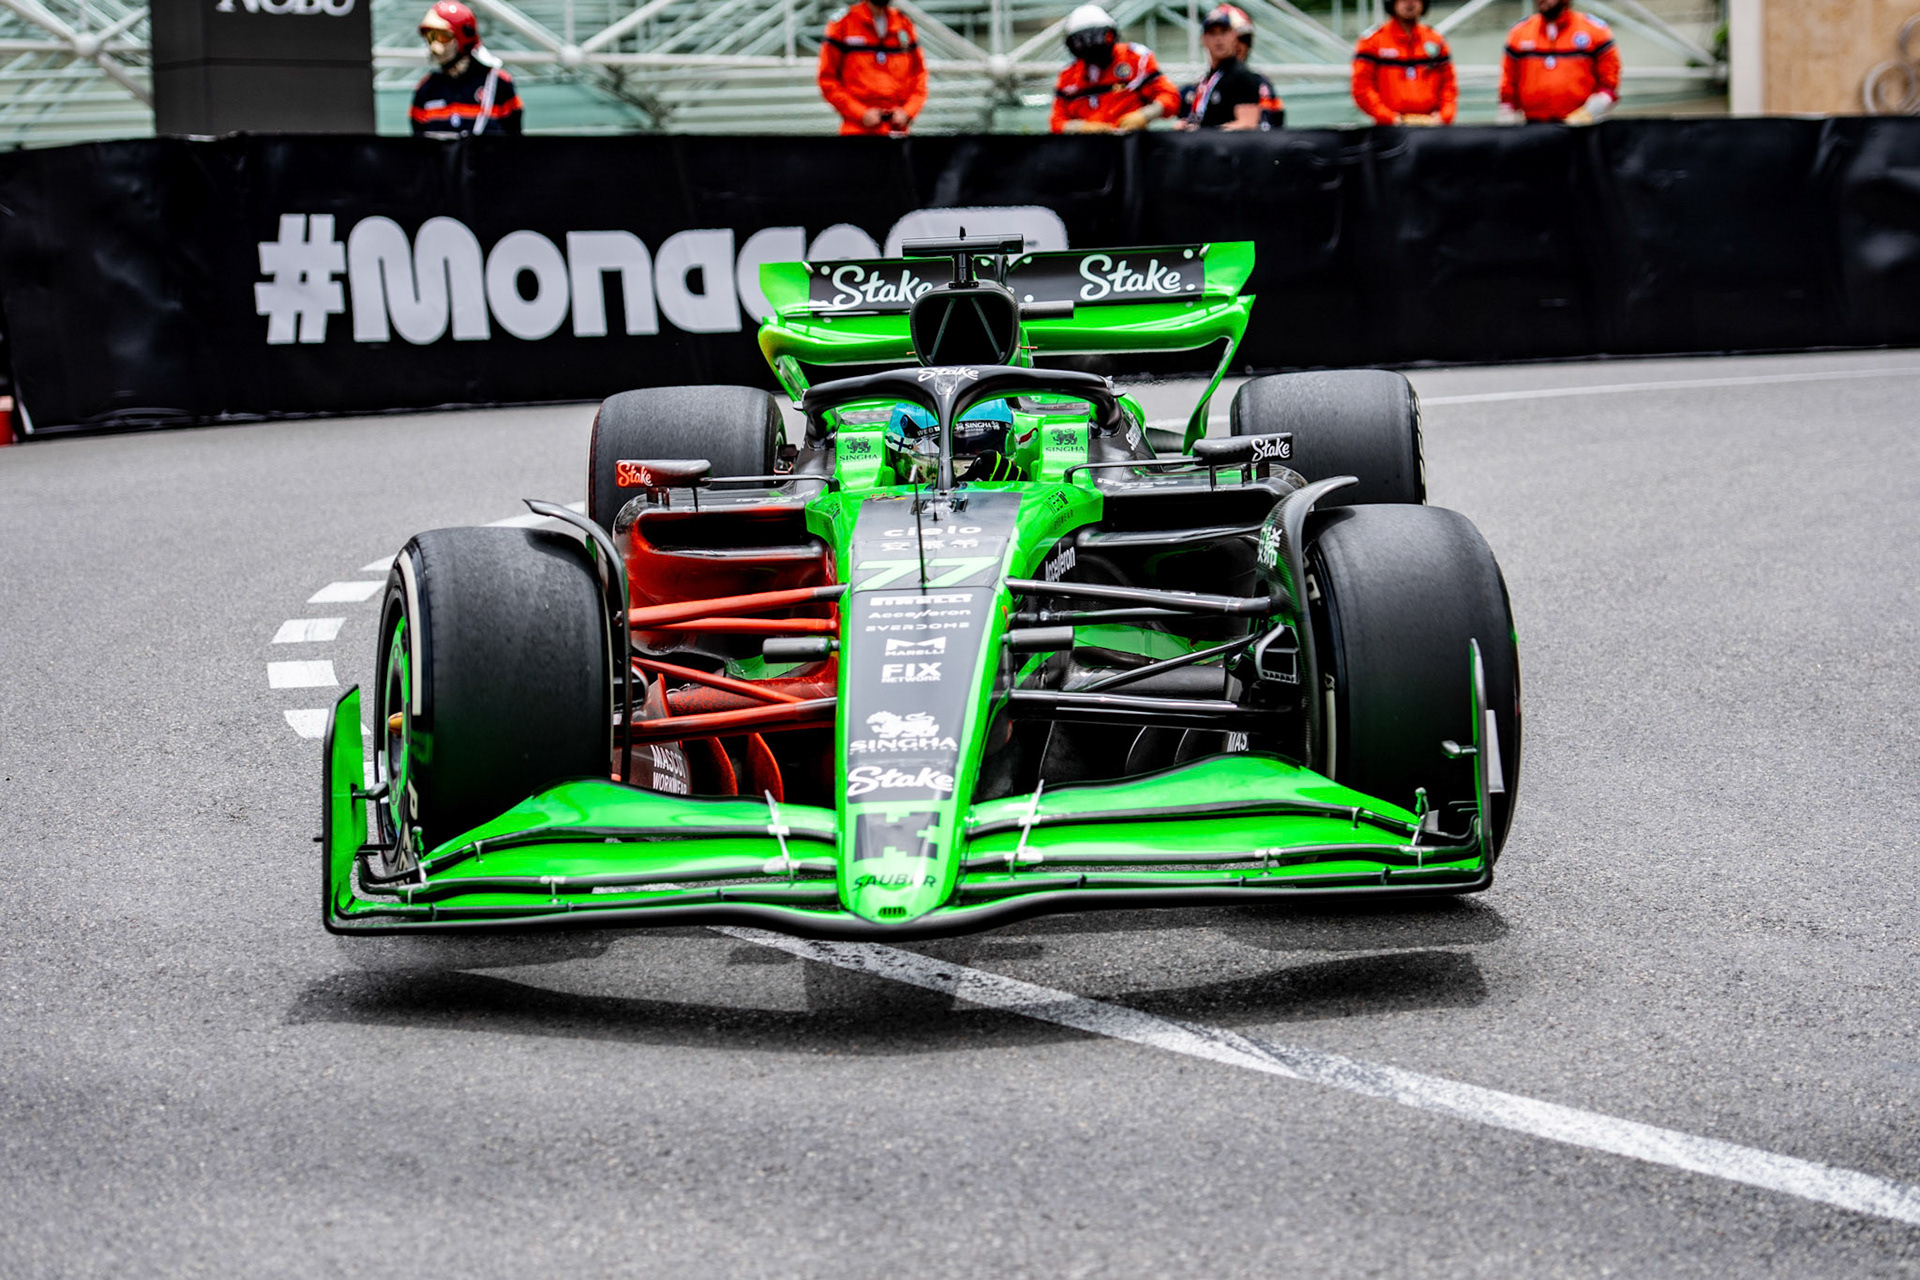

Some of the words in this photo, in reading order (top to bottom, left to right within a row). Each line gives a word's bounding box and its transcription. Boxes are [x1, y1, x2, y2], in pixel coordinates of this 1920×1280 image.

[831, 265, 933, 310] Stake
[1079, 254, 1182, 299] Stake
[918, 367, 979, 382] Stake
[1251, 438, 1290, 462] Stake
[617, 462, 653, 487] Stake
[853, 556, 1000, 593] 77
[866, 622, 969, 631] EVERDOME
[881, 662, 942, 678] FIX
[849, 737, 958, 751] SINGHA
[1227, 731, 1249, 751] MAS
[650, 744, 686, 779] MASCOT
[847, 766, 954, 796] Stake
[852, 873, 937, 892] SAUBR
